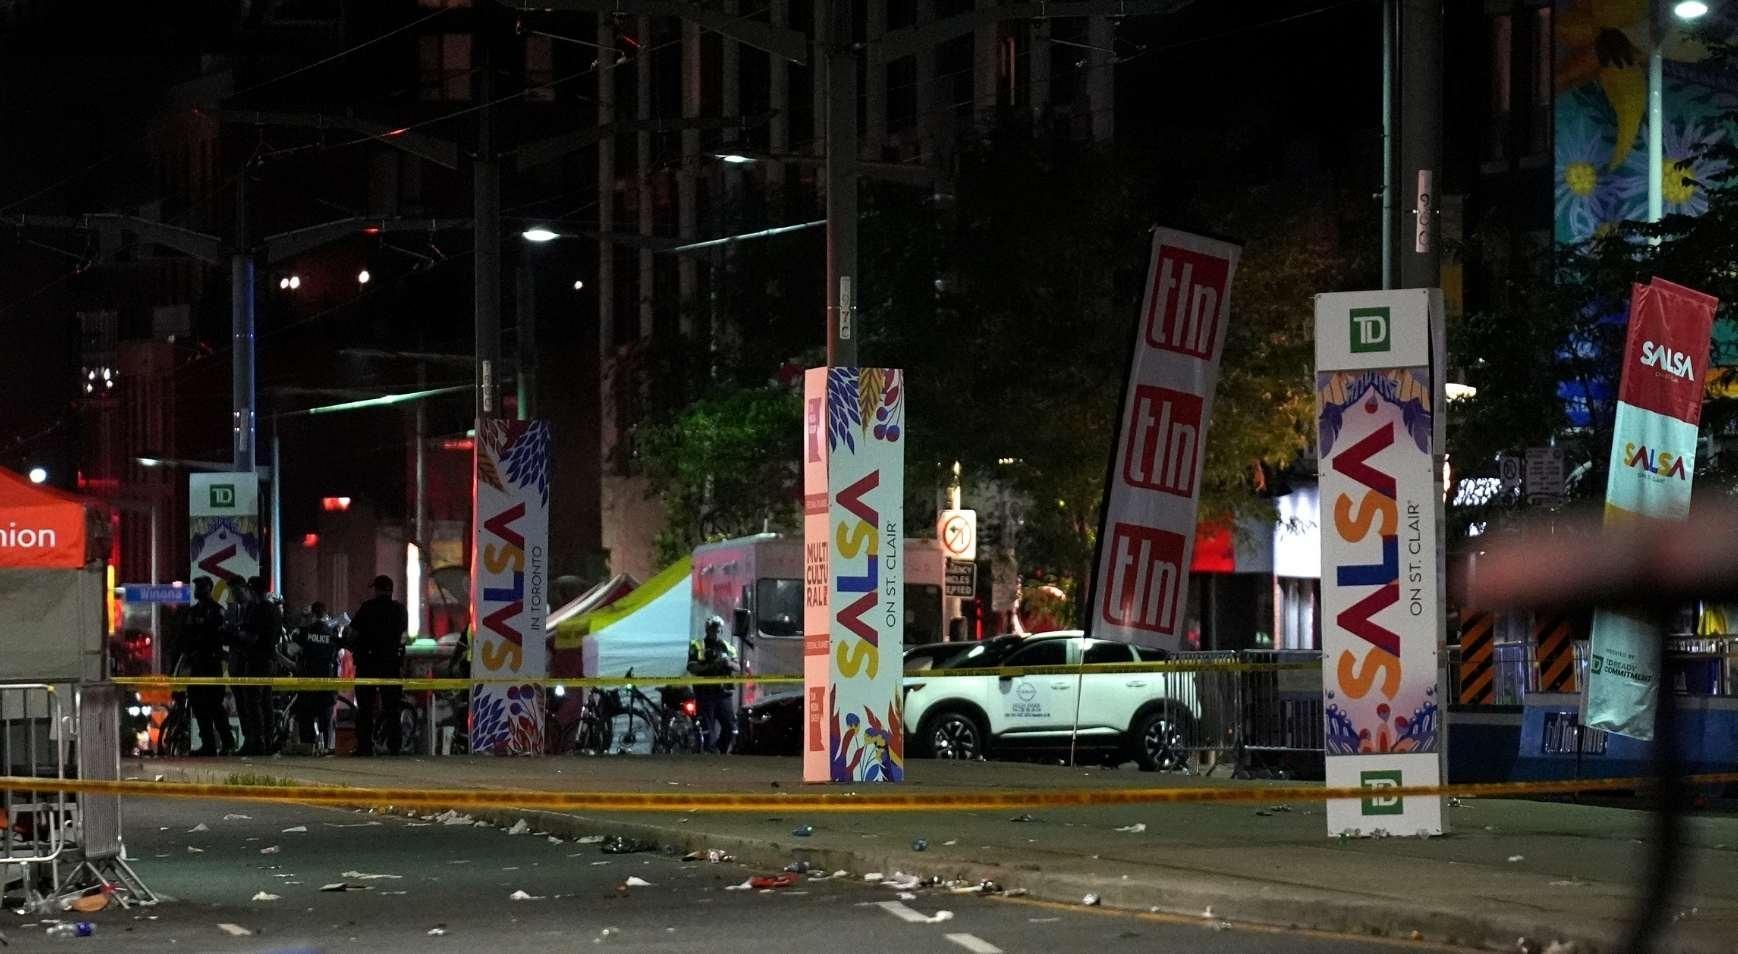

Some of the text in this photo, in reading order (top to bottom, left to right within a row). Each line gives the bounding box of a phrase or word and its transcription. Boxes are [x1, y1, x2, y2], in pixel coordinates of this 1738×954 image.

[1152, 257, 1217, 354] tln
[1353, 316, 1386, 344] TD
[1640, 340, 1694, 381] SALSA
[1130, 397, 1196, 492] tln
[1624, 442, 1685, 480] SALSA
[211, 487, 233, 504] TD
[481, 502, 526, 673] SALSA
[531, 546, 542, 631] IN TORONTO
[806, 564, 828, 585] CULTU
[835, 469, 880, 681] SALSA
[886, 523, 896, 627] ON ST. CLAIR
[1108, 535, 1177, 630] tln
[1332, 422, 1401, 700] SALSA
[1408, 504, 1422, 616] ON ST. CLAIR
[307, 632, 330, 644] POLICE
[1604, 665, 1653, 682] COMMITMENT
[1364, 779, 1398, 806] TD
